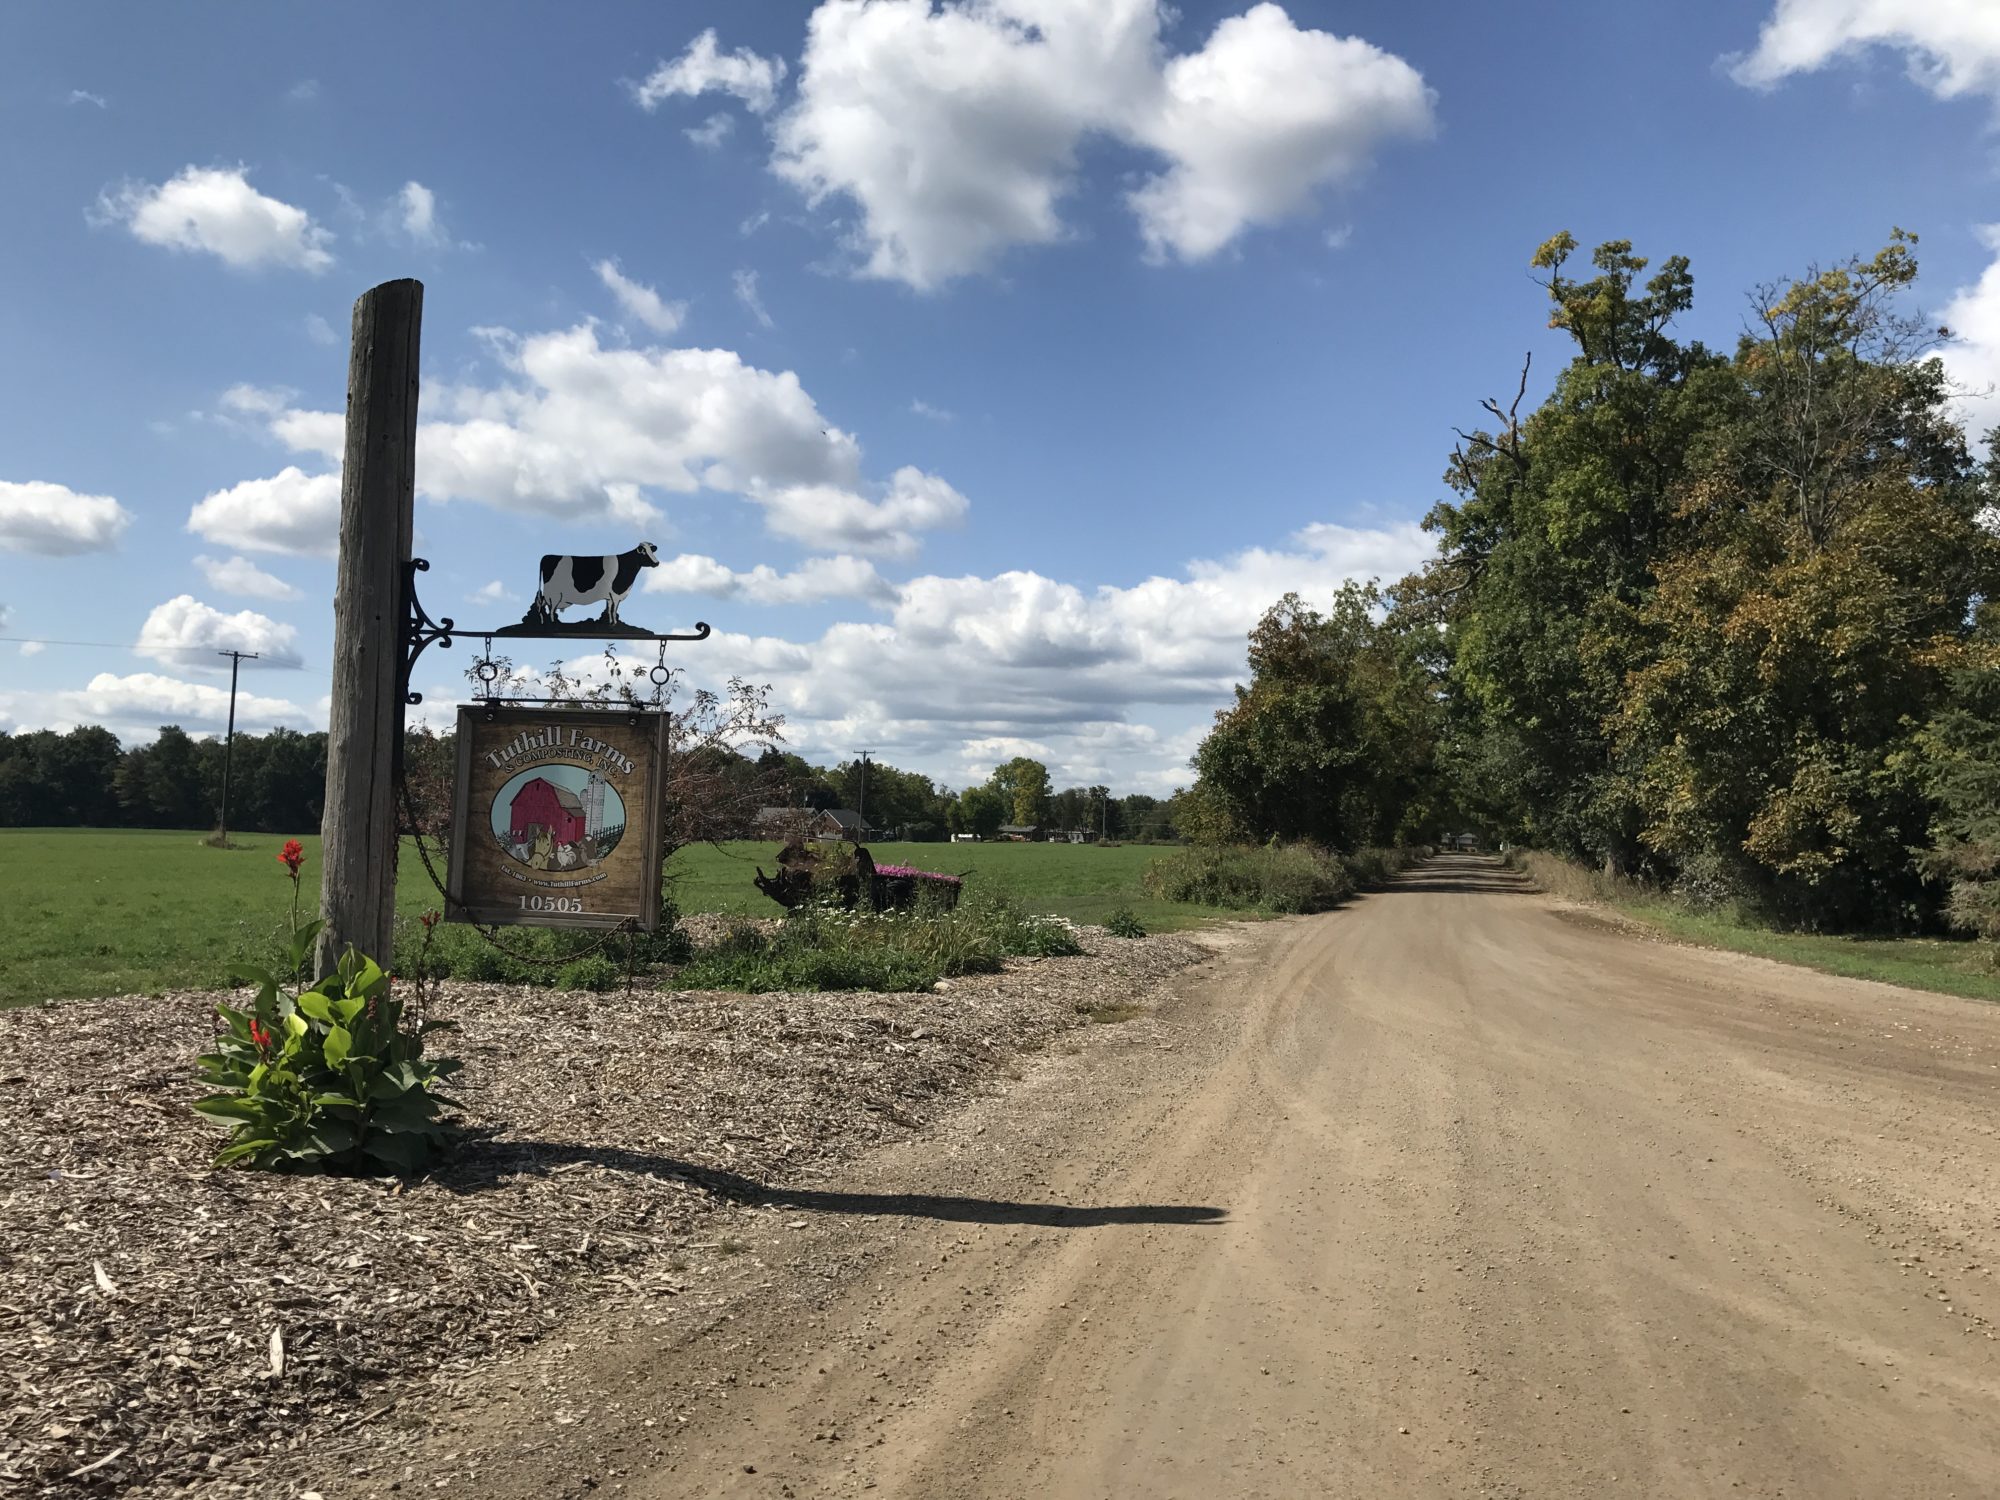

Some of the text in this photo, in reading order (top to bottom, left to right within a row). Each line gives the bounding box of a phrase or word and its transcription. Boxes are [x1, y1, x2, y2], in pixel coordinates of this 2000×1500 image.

[485, 725, 635, 774] Tuthill Farms
[505, 748, 619, 778] & COMPOSTING, INC.
[518, 894, 582, 913] 10505
